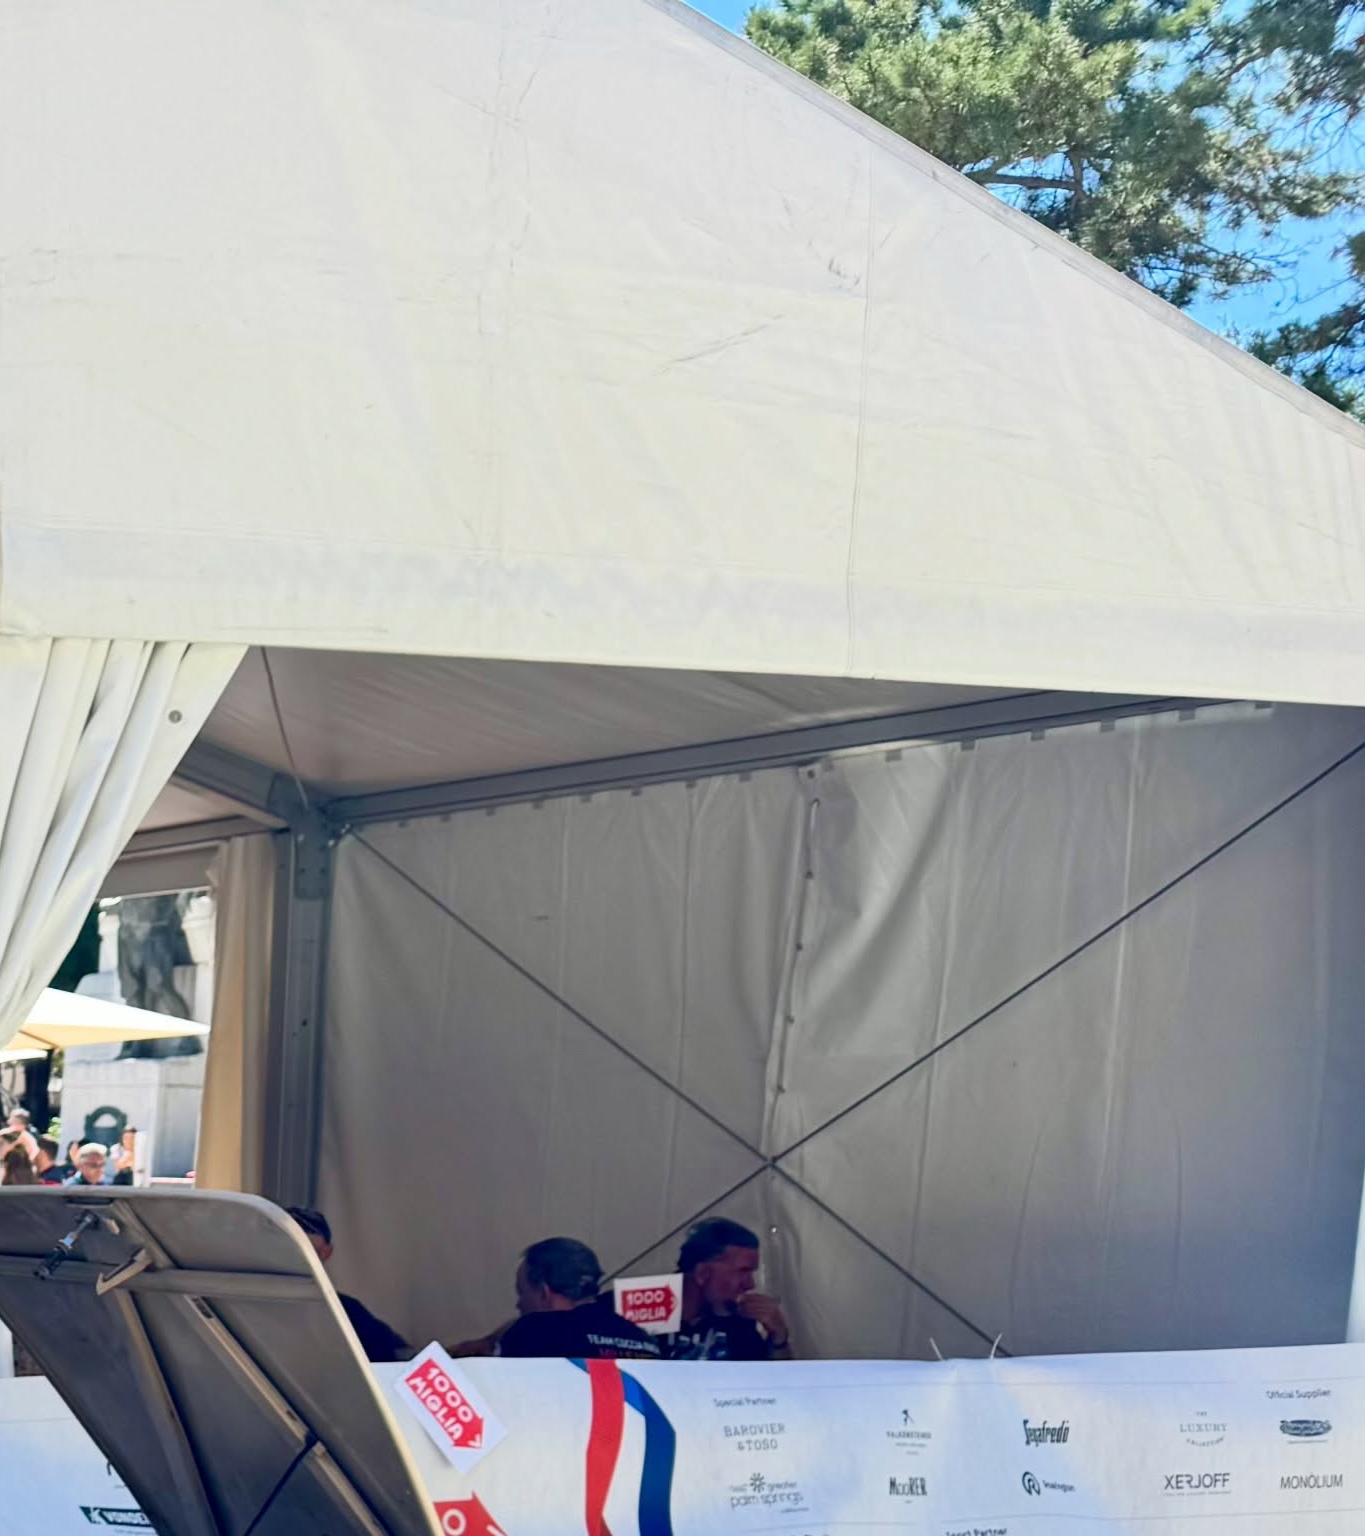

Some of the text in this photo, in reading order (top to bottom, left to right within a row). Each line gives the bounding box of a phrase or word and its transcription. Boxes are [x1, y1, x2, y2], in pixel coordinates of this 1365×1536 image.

[626, 1289, 665, 1306] 1000
[426, 1366, 474, 1423] 1000
[409, 1376, 465, 1440] MIGLIA
[723, 1423, 785, 1437] BAROVIER
[1180, 1423, 1229, 1433] LUXURY
[1164, 1473, 1231, 1490] XERJOFF
